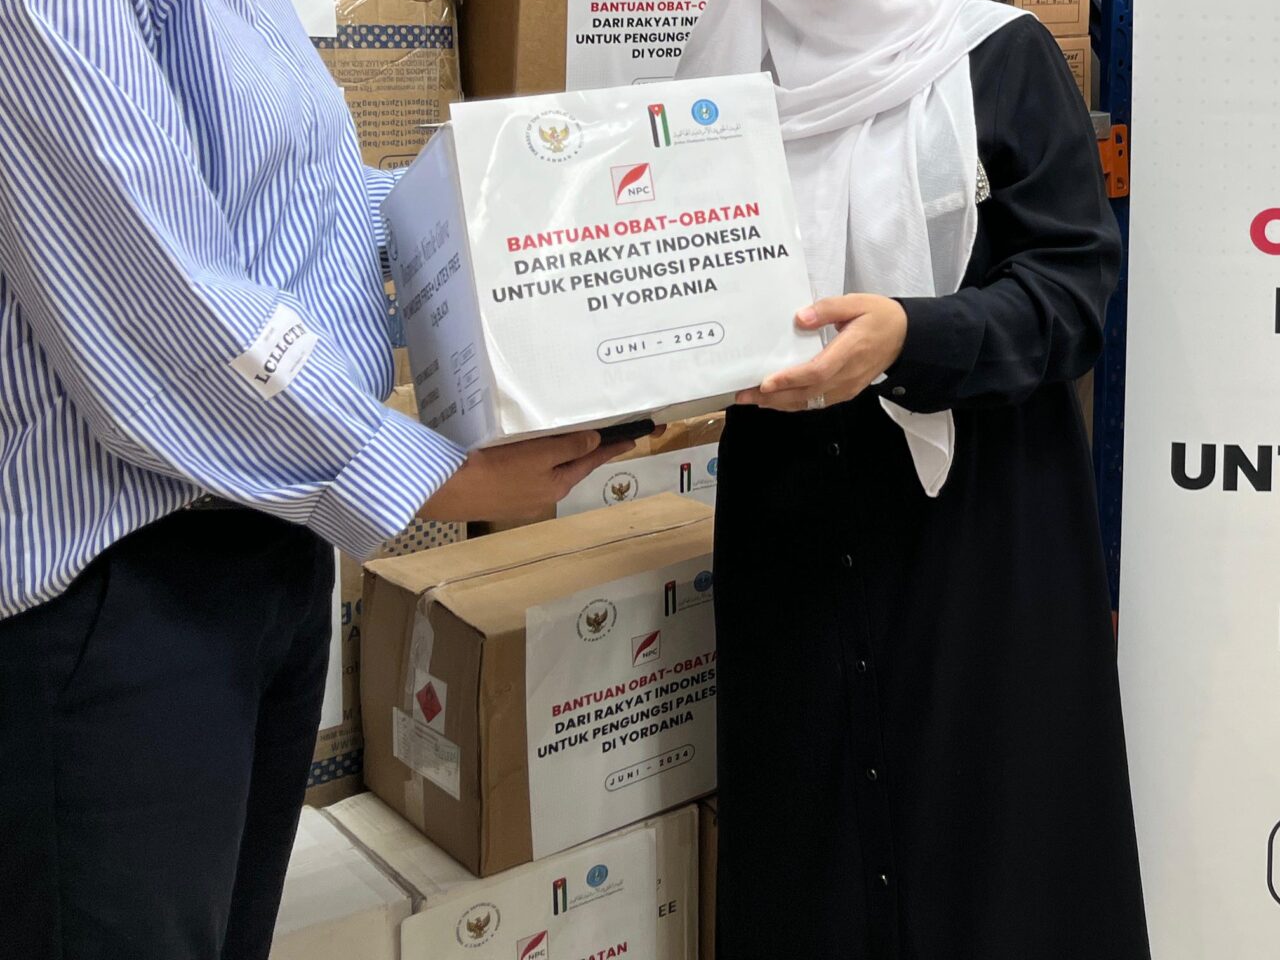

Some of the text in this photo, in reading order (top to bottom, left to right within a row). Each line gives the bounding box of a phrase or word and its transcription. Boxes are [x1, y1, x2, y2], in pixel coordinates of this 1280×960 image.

[590, 1, 656, 13] BANTUAN
[592, 18, 624, 29] DARI
[627, 16, 678, 28] RAKYAT
[575, 31, 691, 45] UNTUK PENGUNGS
[631, 47, 682, 59] DI YORD
[627, 185, 650, 197] NPC
[506, 202, 761, 253] BANTUAN OBAT-OBATAN
[514, 224, 761, 276] DARI RAKYAT INDONESIA
[491, 277, 567, 304] UNTUK
[570, 259, 686, 291] PENGUNGSI
[690, 243, 790, 272] PALESTINA
[587, 277, 718, 313] DI YORDANIA
[604, 339, 647, 357] JUNI
[674, 327, 716, 344] 2024
[552, 683, 626, 717] BANTUAN
[555, 668, 716, 735] DARI RAKYAT INDONES
[537, 700, 674, 759] UNTUK PENGUNGSI
[602, 710, 694, 754] DI YORDANIA
[609, 749, 690, 787] JUNI 2024
